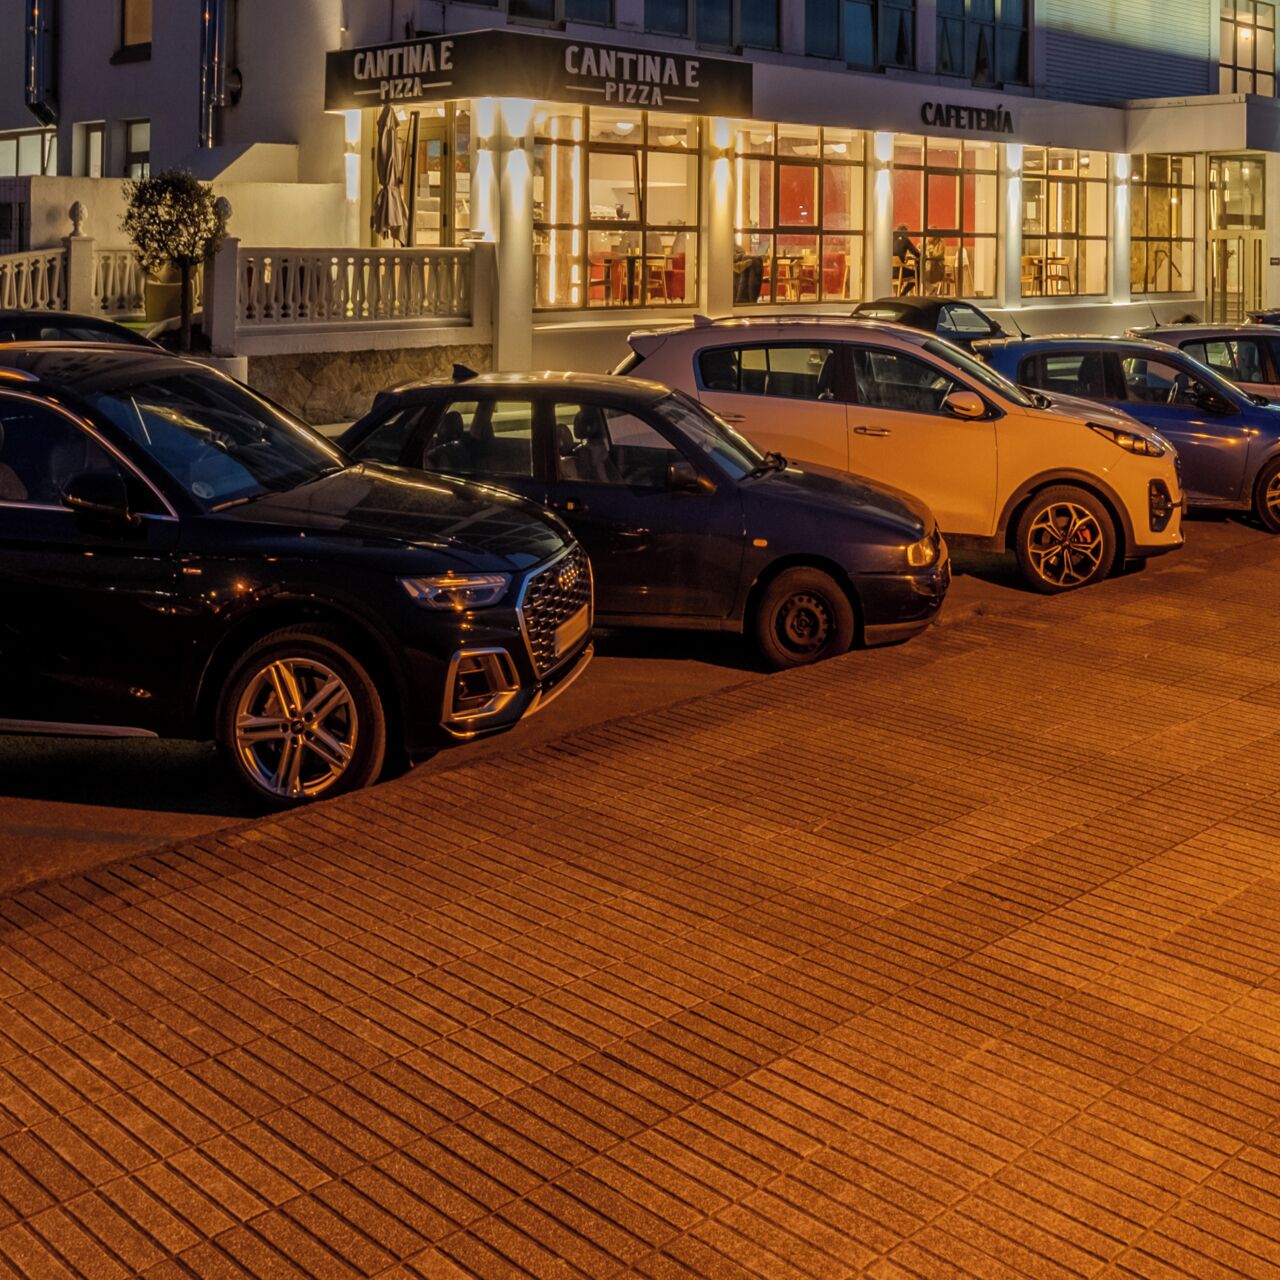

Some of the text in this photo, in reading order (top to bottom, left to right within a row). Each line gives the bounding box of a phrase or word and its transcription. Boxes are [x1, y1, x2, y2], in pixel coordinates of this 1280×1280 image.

[353, 40, 454, 80] CANTINA E
[565, 45, 700, 88] CANTINA E
[380, 77, 423, 100] PIZZA
[605, 81, 664, 106] PIZZA
[921, 101, 1014, 134] CAFETERÍA
